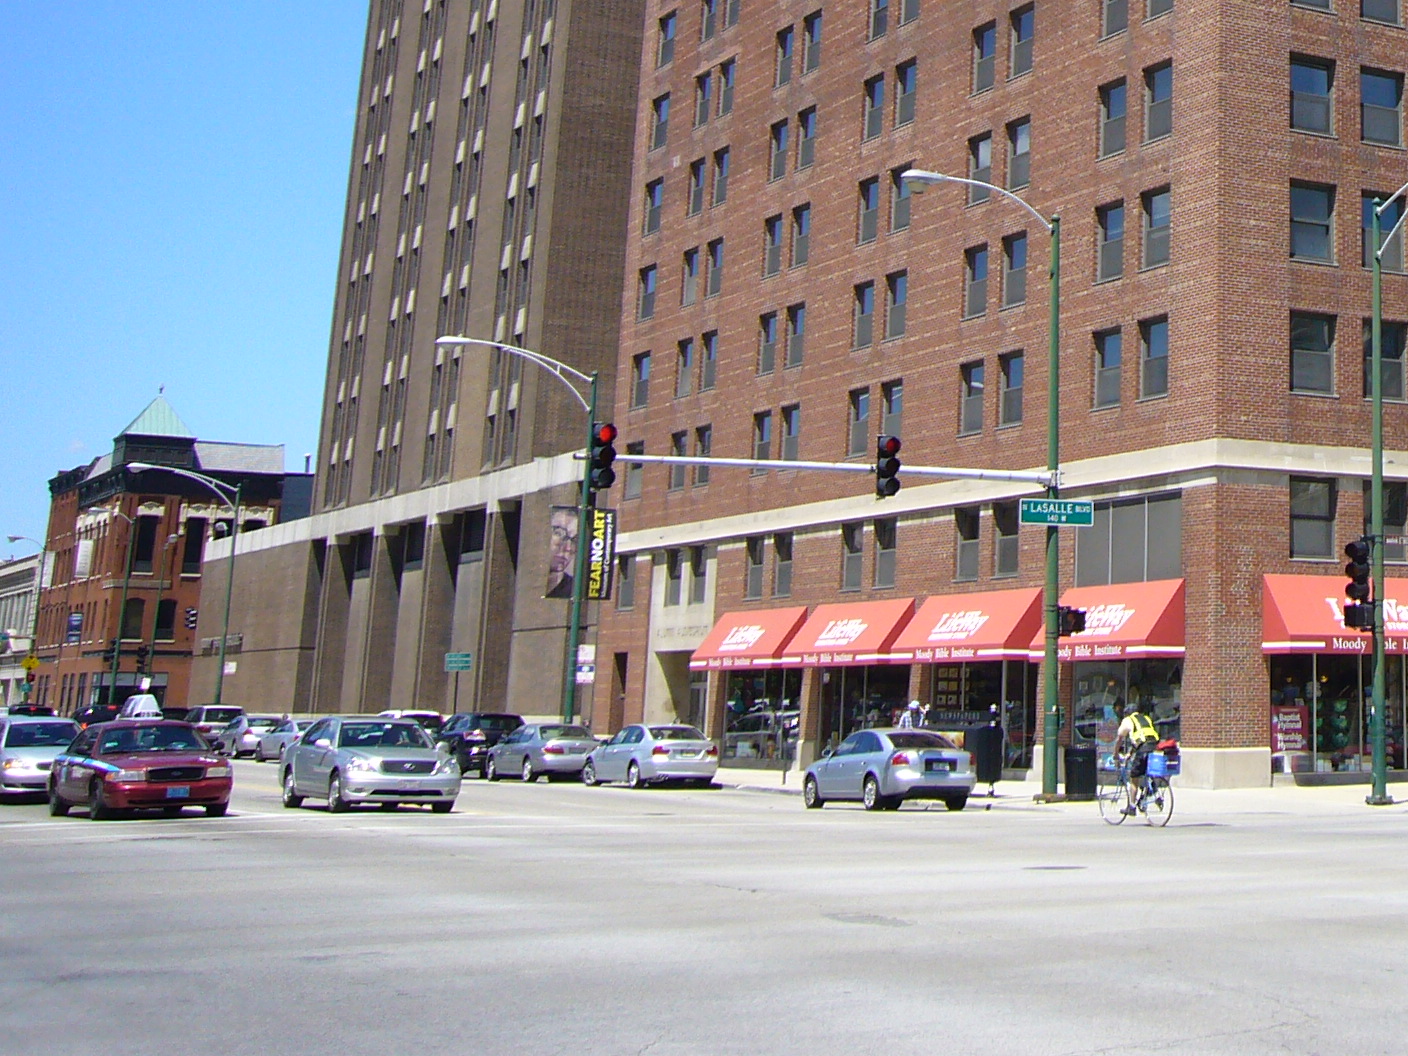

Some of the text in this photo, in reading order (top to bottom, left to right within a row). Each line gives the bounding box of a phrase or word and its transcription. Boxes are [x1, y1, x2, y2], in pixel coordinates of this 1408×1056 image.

[1078, 603, 1136, 632] ifeWay
[1056, 644, 1122, 660] oody Bible Institute
[1333, 637, 1367, 653] Moody
[915, 647, 975, 662] Moody Bible Institute
